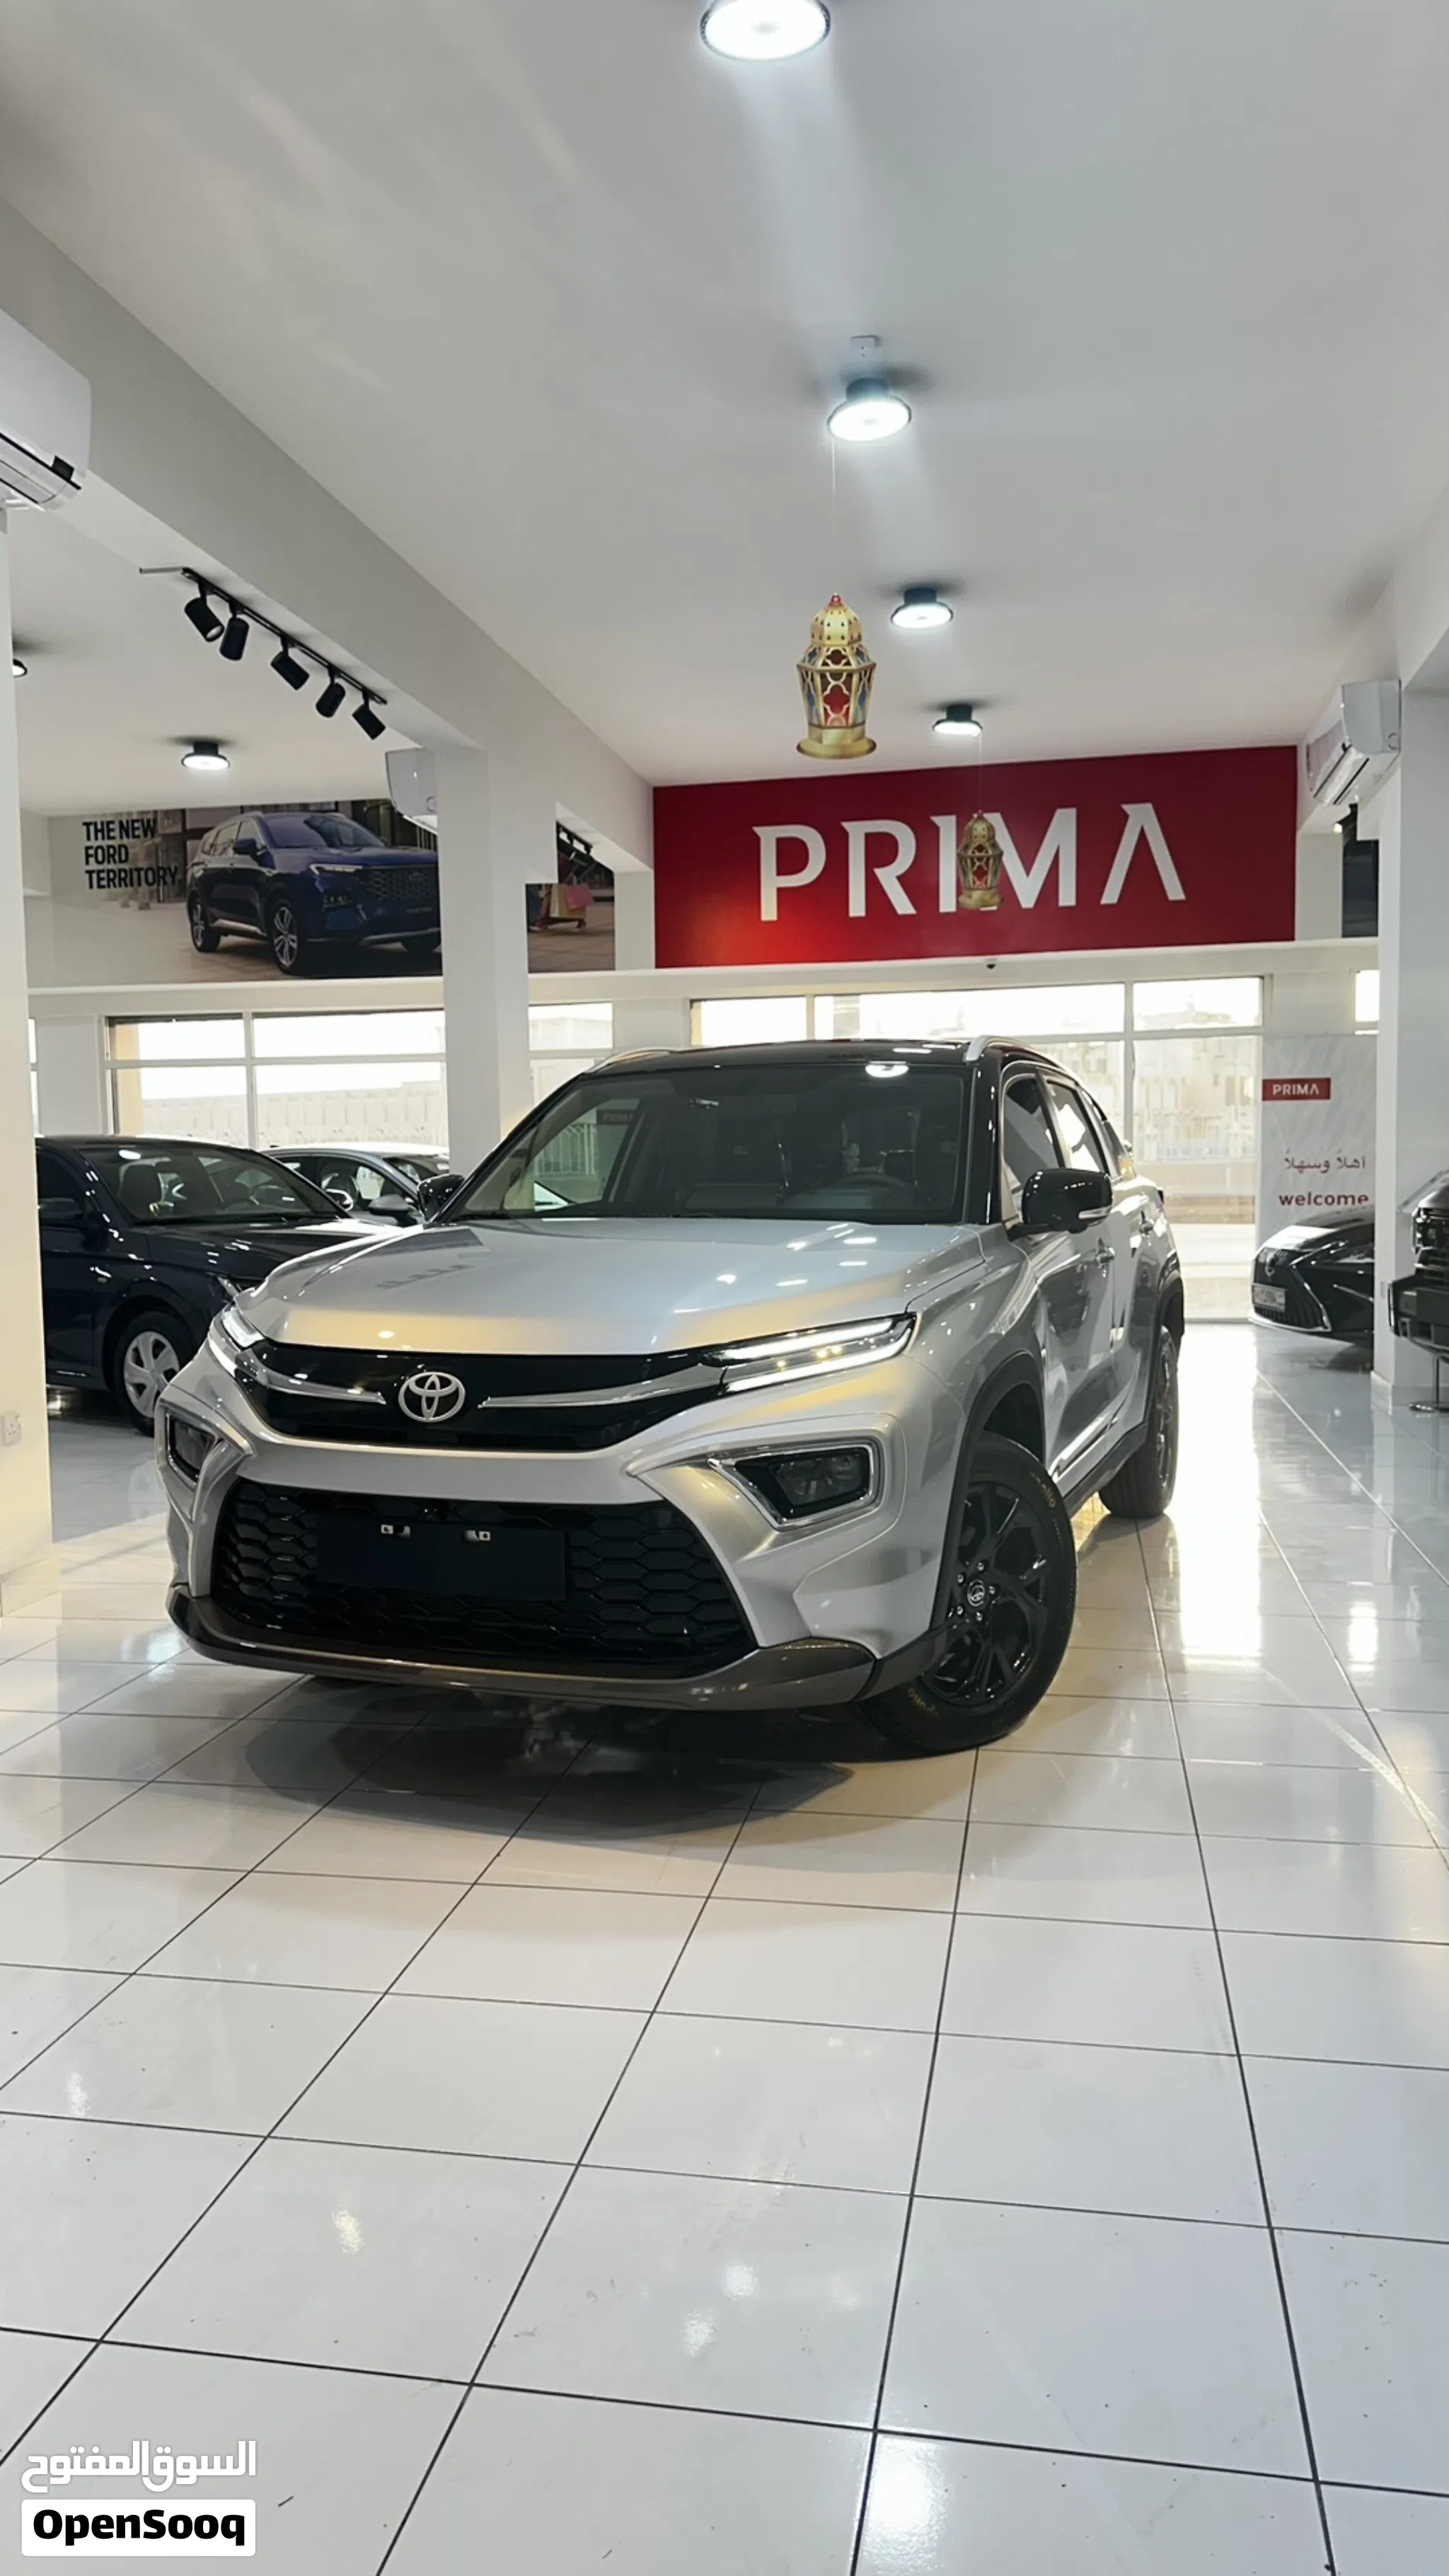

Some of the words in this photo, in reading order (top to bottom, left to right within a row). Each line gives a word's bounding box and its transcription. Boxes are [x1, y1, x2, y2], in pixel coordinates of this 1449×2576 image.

[83, 821, 115, 841] THE
[119, 819, 156, 840] NEW
[85, 844, 129, 865] FORD
[752, 802, 1186, 922] PRIMA
[86, 865, 177, 889] TERRITORY
[1273, 1083, 1320, 1096] PRIMA
[1279, 1191, 1369, 1206] welcome
